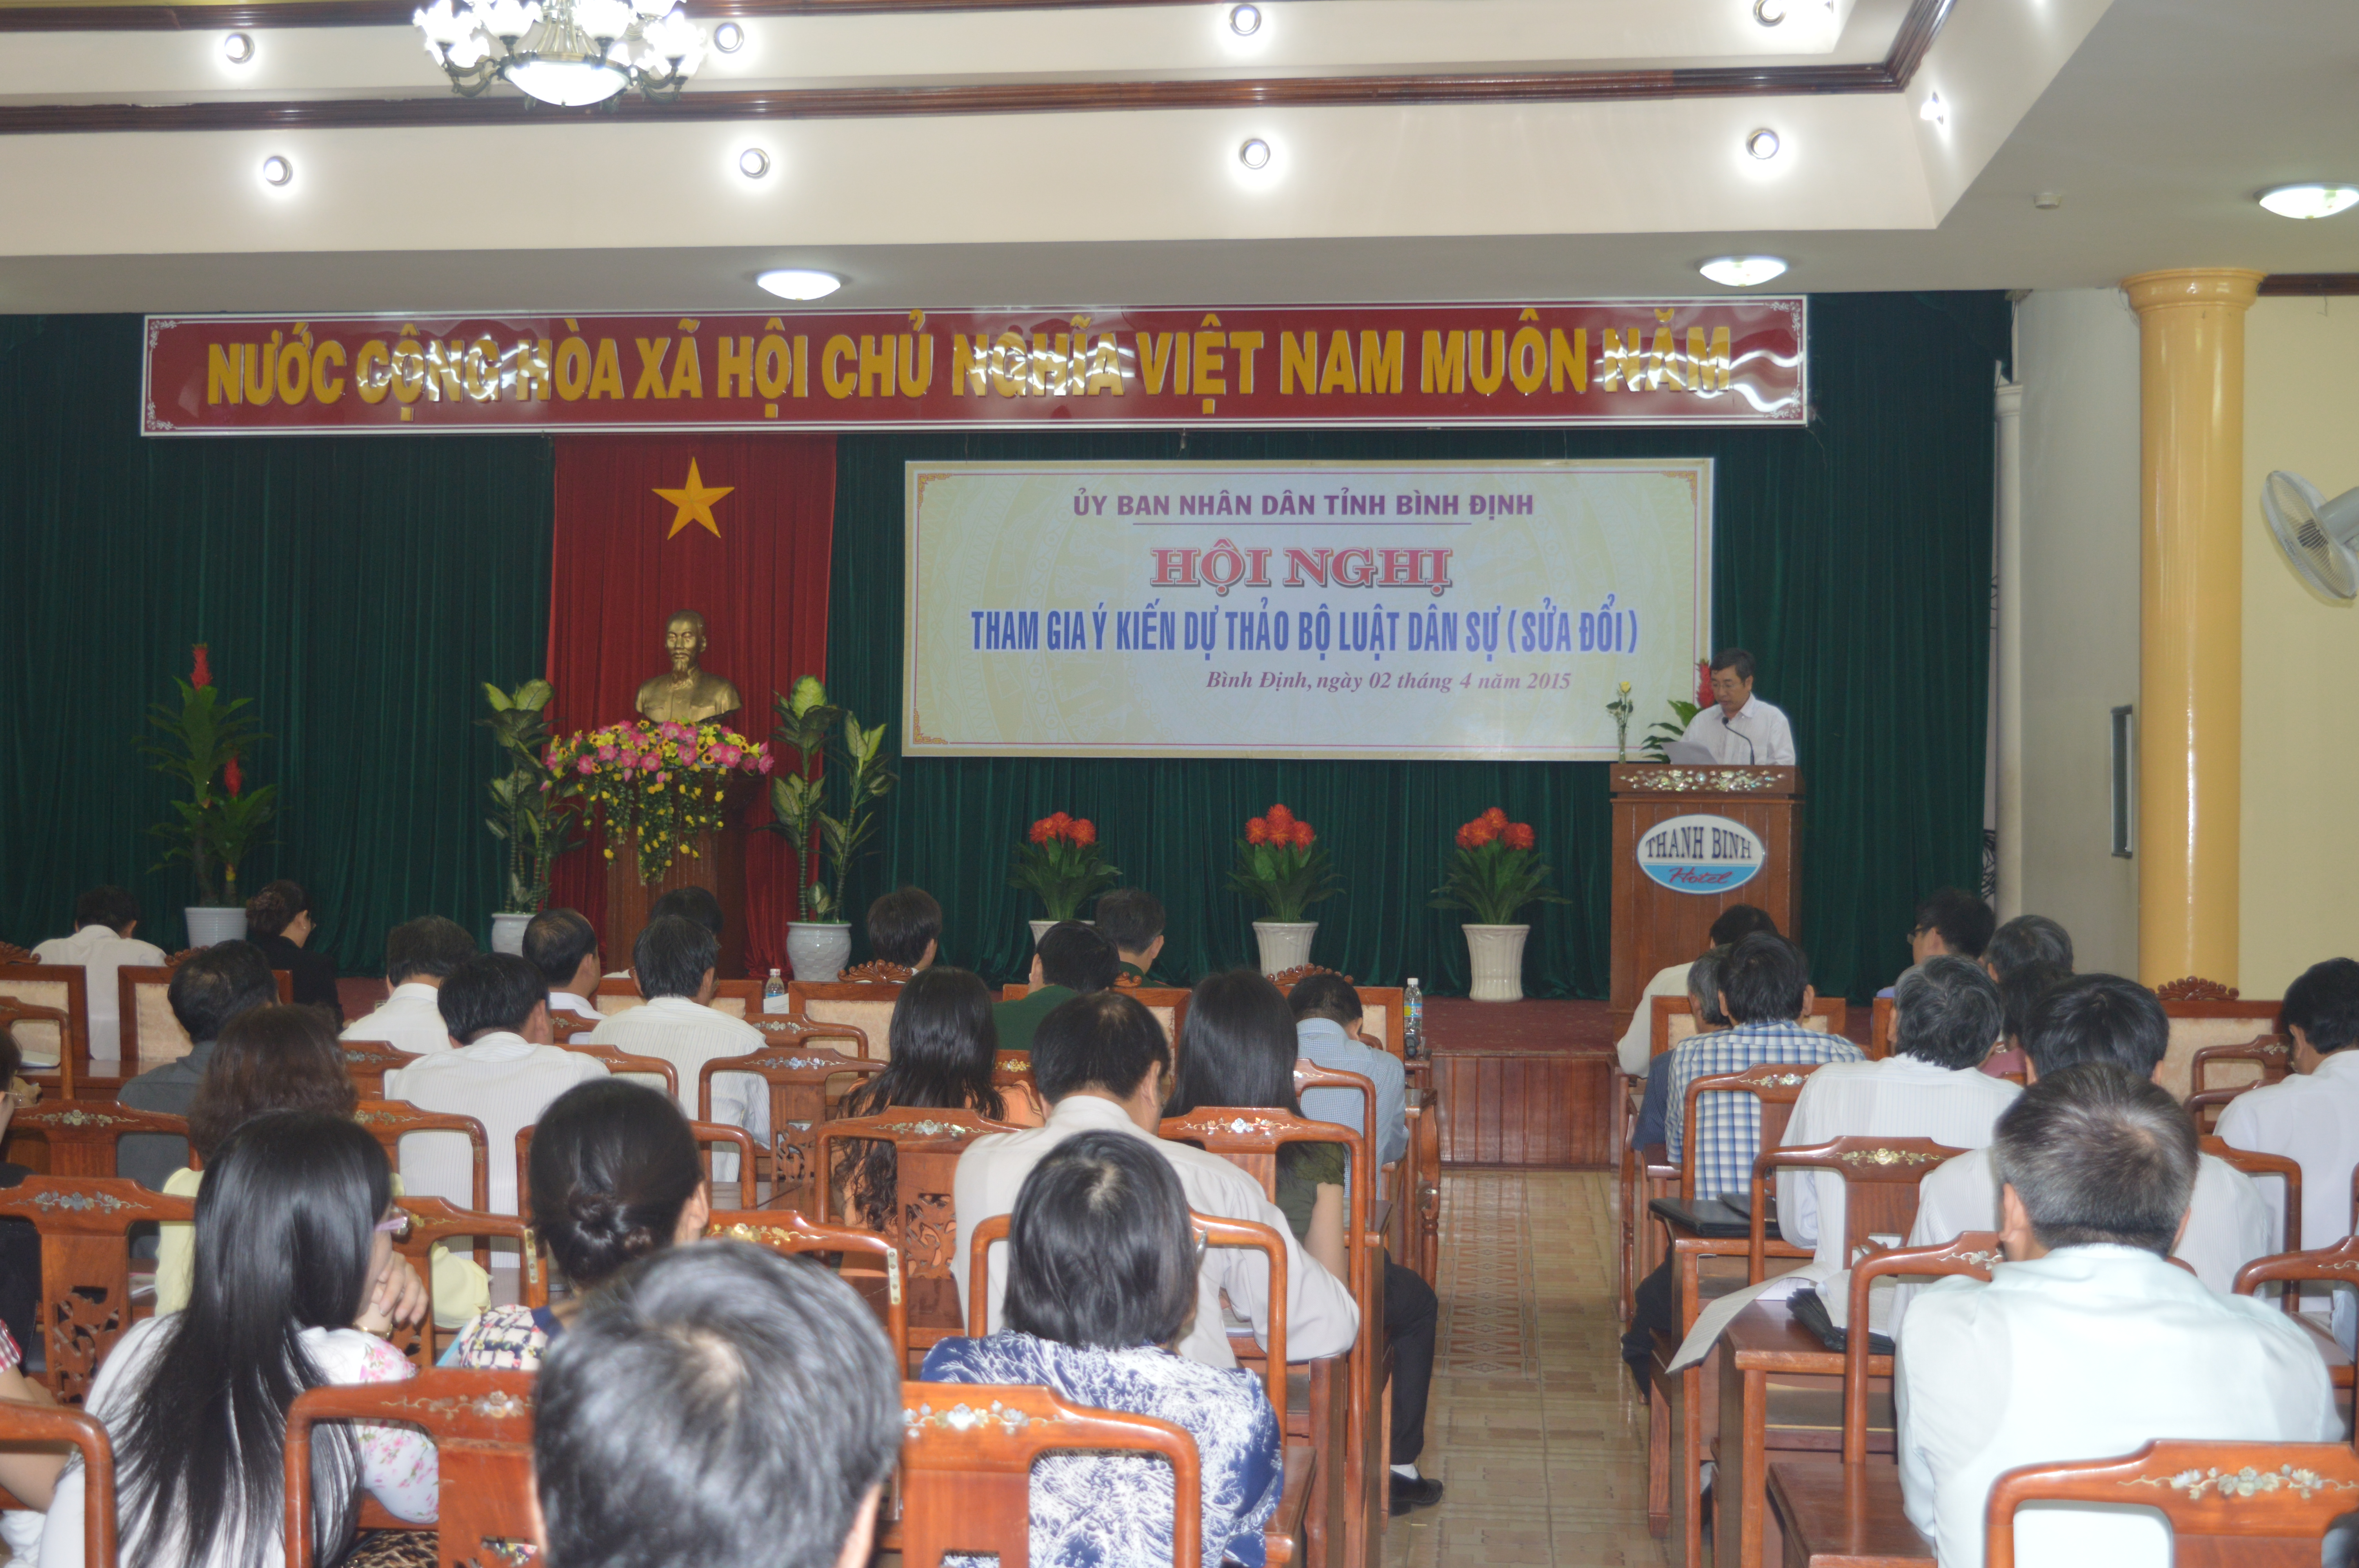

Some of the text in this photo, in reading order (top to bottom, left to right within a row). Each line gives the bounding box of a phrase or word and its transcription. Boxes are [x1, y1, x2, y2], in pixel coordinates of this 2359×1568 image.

[207, 308, 1730, 422] NƯỚC CỘNG HÒA XÃ HỘI CHỦ NGHĨA VIỆT NAM MUÔN NĂM
[1073, 487, 1534, 521] ỦY BAN NHÂN DÂN TỈNH BÌNH ĐỊNH
[1150, 537, 1453, 597] HỘI NGHỊ
[971, 593, 1637, 662] THAM GIA Ý KIẾN DỰ THẢO BỘ LUẬT DÂN SỰ (SỬA ĐỔI)
[1206, 671, 1571, 693] Bình Định, ngày 02 tháng 4 năm 2015
[1646, 826, 1751, 858] THANH BINH
[1669, 867, 1733, 884] Hotel
